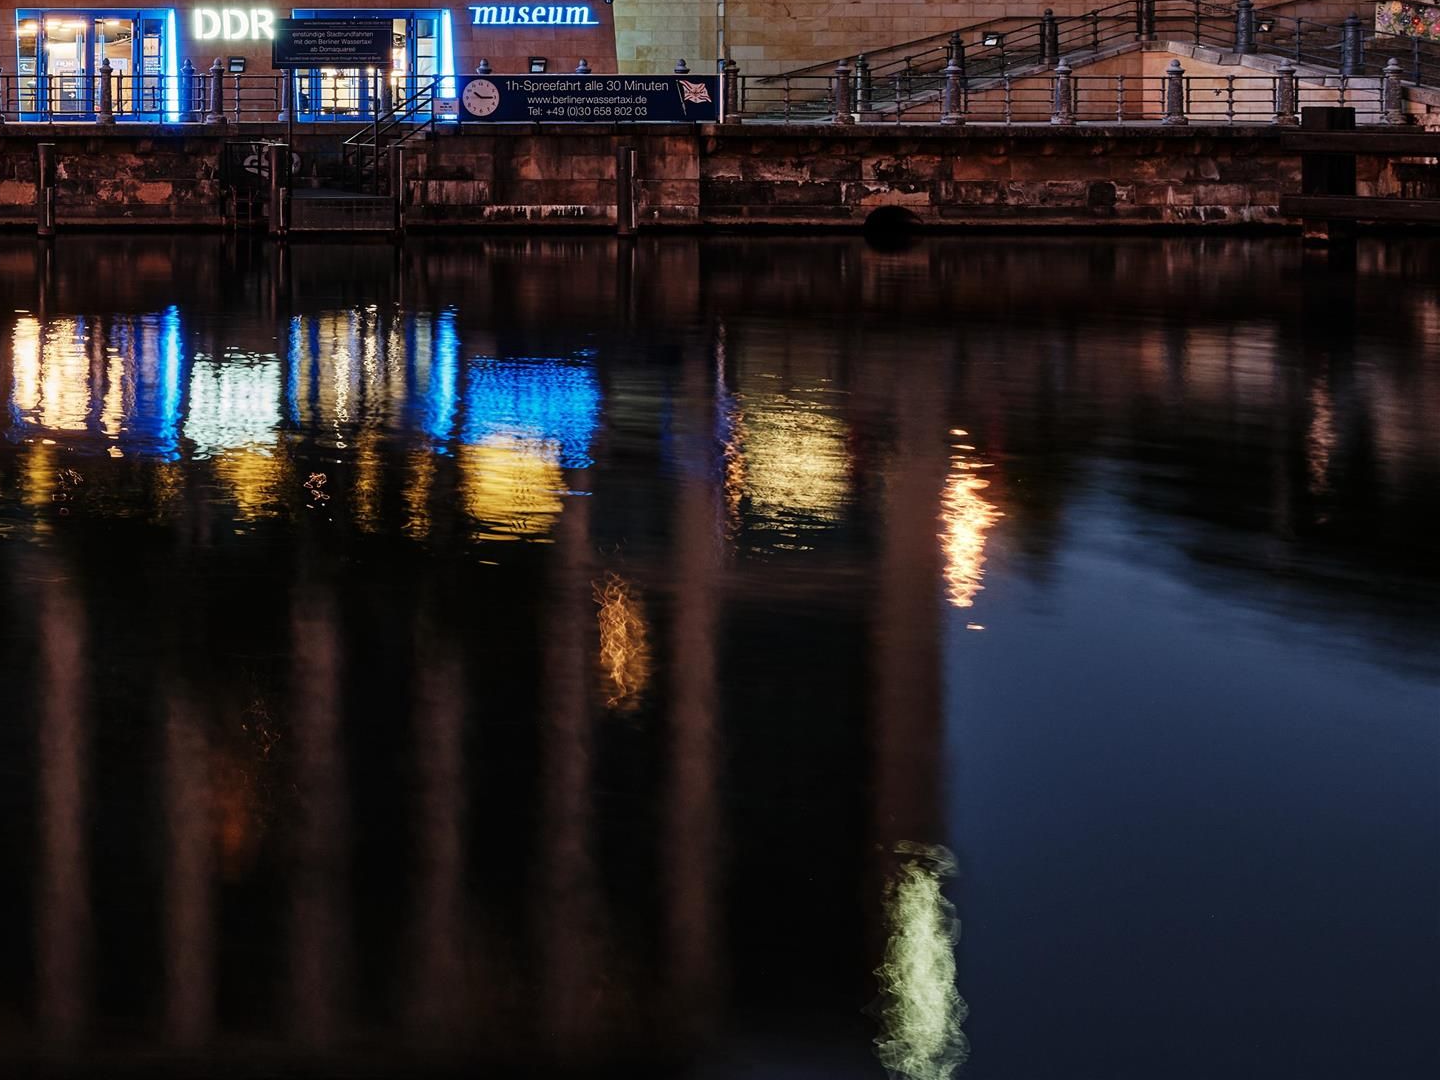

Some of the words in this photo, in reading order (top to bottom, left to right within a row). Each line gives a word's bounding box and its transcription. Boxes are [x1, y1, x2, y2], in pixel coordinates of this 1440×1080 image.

[468, 6, 600, 25] museum
[194, 8, 275, 40] DDR
[505, 80, 581, 93] 1h-Spreefahrt
[584, 80, 604, 91] alle
[606, 80, 621, 91] 30
[624, 80, 669, 91] Minuten
[527, 95, 647, 104] www.berlinerwassertaxi.de
[528, 106, 543, 116] Tel:
[546, 106, 565, 116] +49
[566, 106, 591, 117] (0)30
[593, 106, 612, 116] 658
[614, 106, 632, 116] 802
[634, 106, 648, 116] 03
